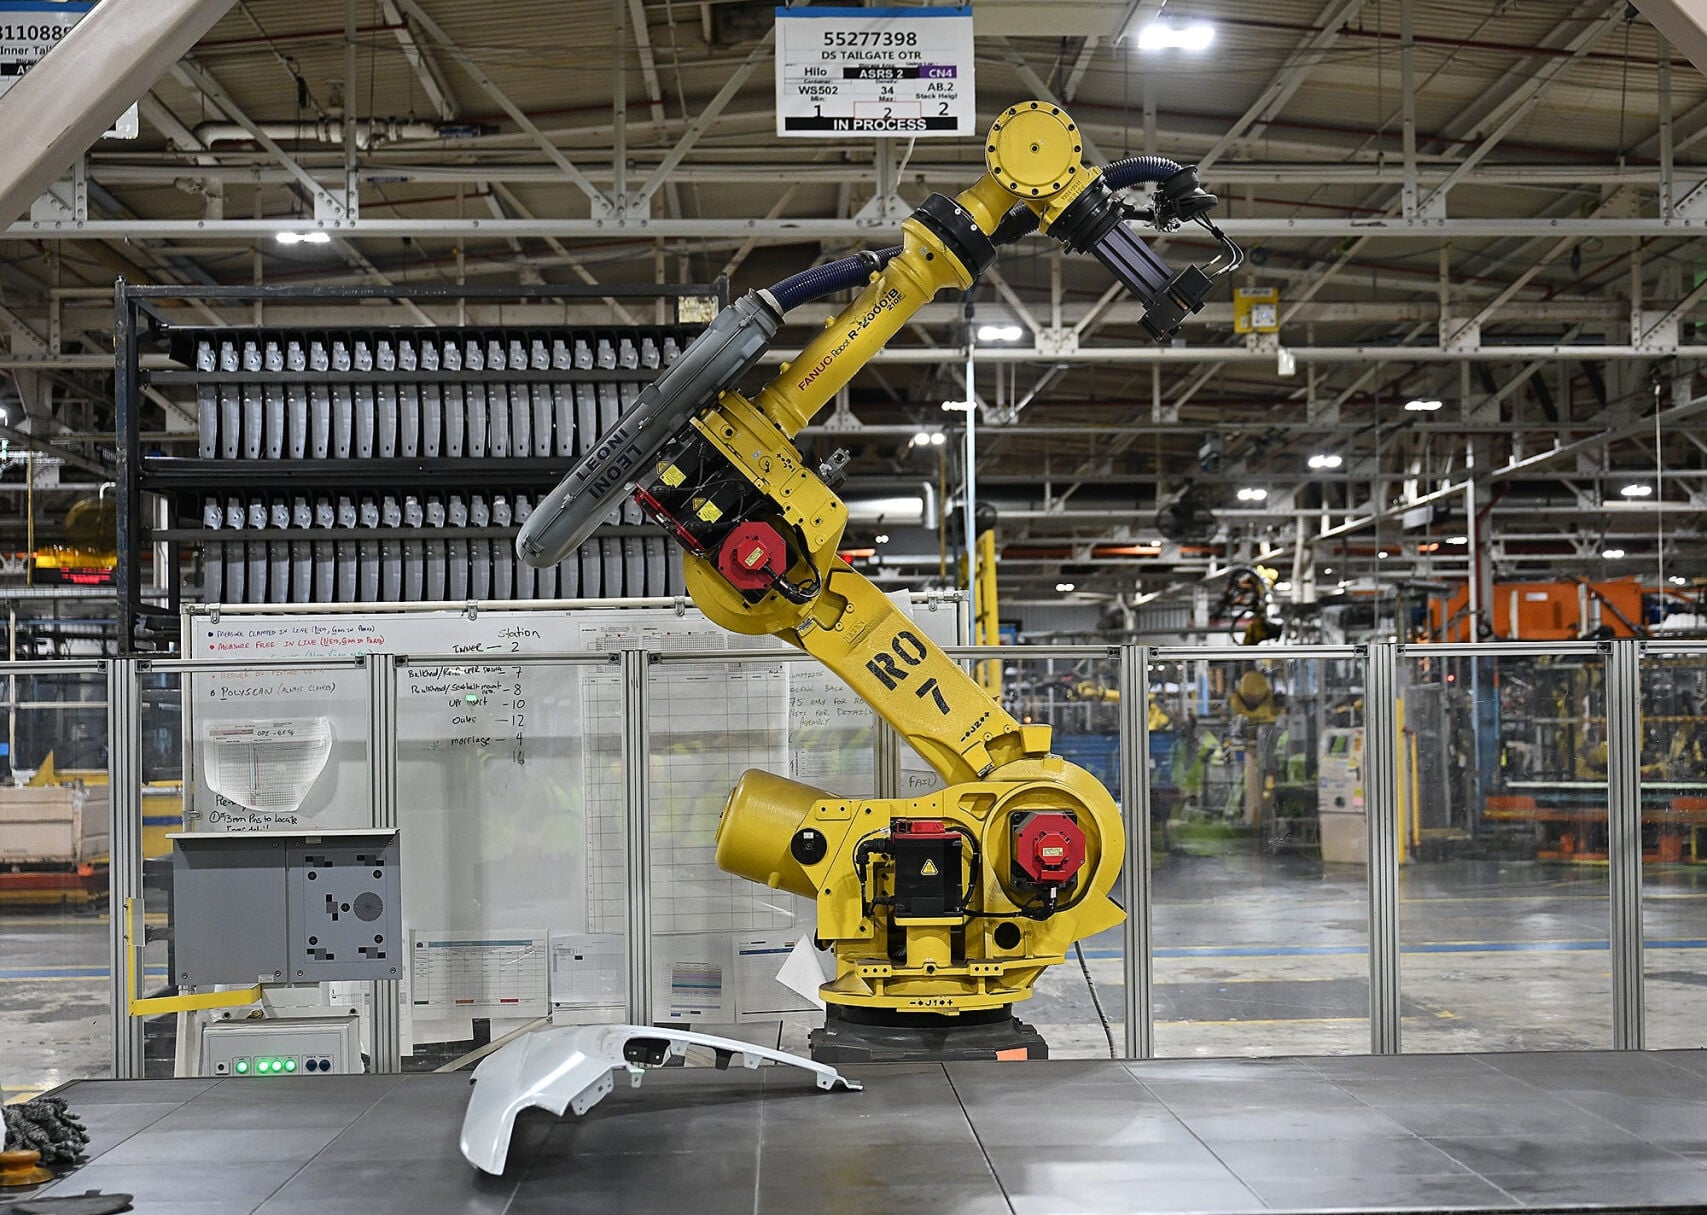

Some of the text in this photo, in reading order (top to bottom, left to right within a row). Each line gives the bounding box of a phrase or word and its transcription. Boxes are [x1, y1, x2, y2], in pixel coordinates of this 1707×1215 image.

[0, 25, 71, 40] 11088
[824, 32, 917, 46] 55277398
[821, 51, 921, 60] DS TAILGATE OTR
[804, 67, 827, 76] Hilo
[859, 69, 903, 79] ASRS 2
[928, 68, 953, 78] CN4
[798, 86, 839, 95] WS502
[881, 86, 894, 95] 34
[927, 82, 954, 91] AB.2
[814, 105, 824, 118] 1
[883, 107, 892, 118] 2
[938, 102, 949, 116] 2
[834, 119, 927, 130] IN PROCESS
[797, 355, 833, 391] FANUC
[830, 339, 850, 358] Robot
[576, 428, 630, 481] LEONI
[588, 444, 642, 499] LEONI
[497, 626, 541, 639] Station
[256, 641, 275, 649] FREE
[511, 641, 520, 652] 2
[865, 630, 928, 691] RO
[511, 666, 522, 678] 7
[220, 686, 273, 698] POLYSCAN
[513, 683, 522, 695] 8
[914, 677, 951, 715] 7
[512, 700, 525, 709] 10
[512, 714, 524, 726] 12
[516, 732, 523, 746] 4
